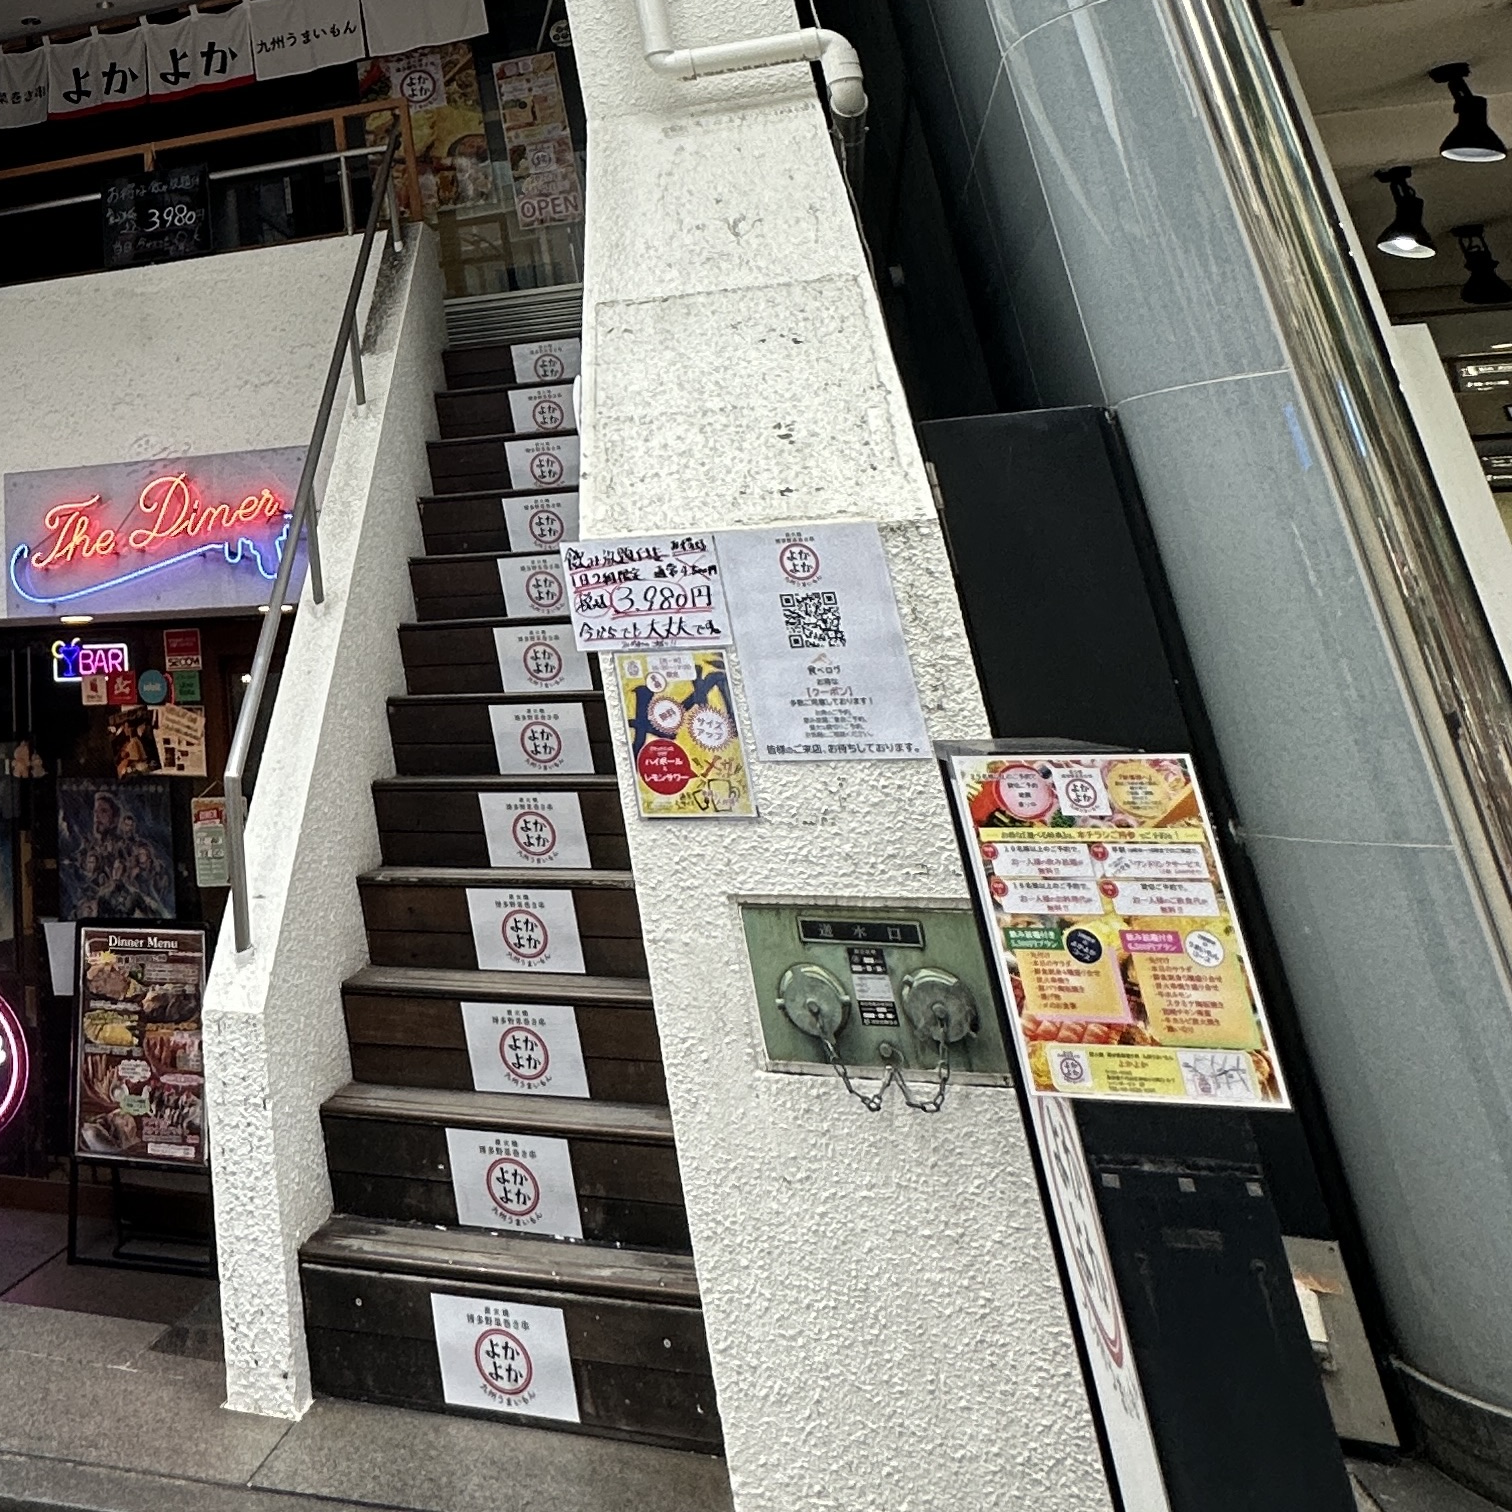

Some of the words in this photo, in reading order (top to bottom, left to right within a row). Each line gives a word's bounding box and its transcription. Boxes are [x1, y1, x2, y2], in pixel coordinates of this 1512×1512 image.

[256, 19, 358, 56] 九州うまいもん
[520, 194, 579, 219] OPEN
[31, 493, 115, 569] The
[129, 472, 285, 547] Diner
[786, 548, 811, 561] よか
[789, 560, 815, 573] よか
[78, 648, 123, 675] BAR
[167, 657, 201, 668] SECOM
[530, 648, 554, 662] よか
[533, 661, 556, 675] よか
[807, 665, 841, 676] 食べログ
[527, 728, 553, 742] よか
[530, 741, 556, 756] よか
[520, 818, 548, 833] よか
[523, 833, 550, 849] よか
[510, 917, 538, 934] よか
[818, 921, 902, 941] 送水口
[108, 935, 143, 950] Dinner
[146, 935, 178, 950] Menu
[513, 934, 541, 950] よか
[508, 1034, 539, 1053] よか
[511, 1052, 542, 1071] よか
[496, 1166, 529, 1187] よか
[500, 1186, 532, 1207] よか
[485, 1338, 521, 1362] よか
[488, 1361, 524, 1384] よか
